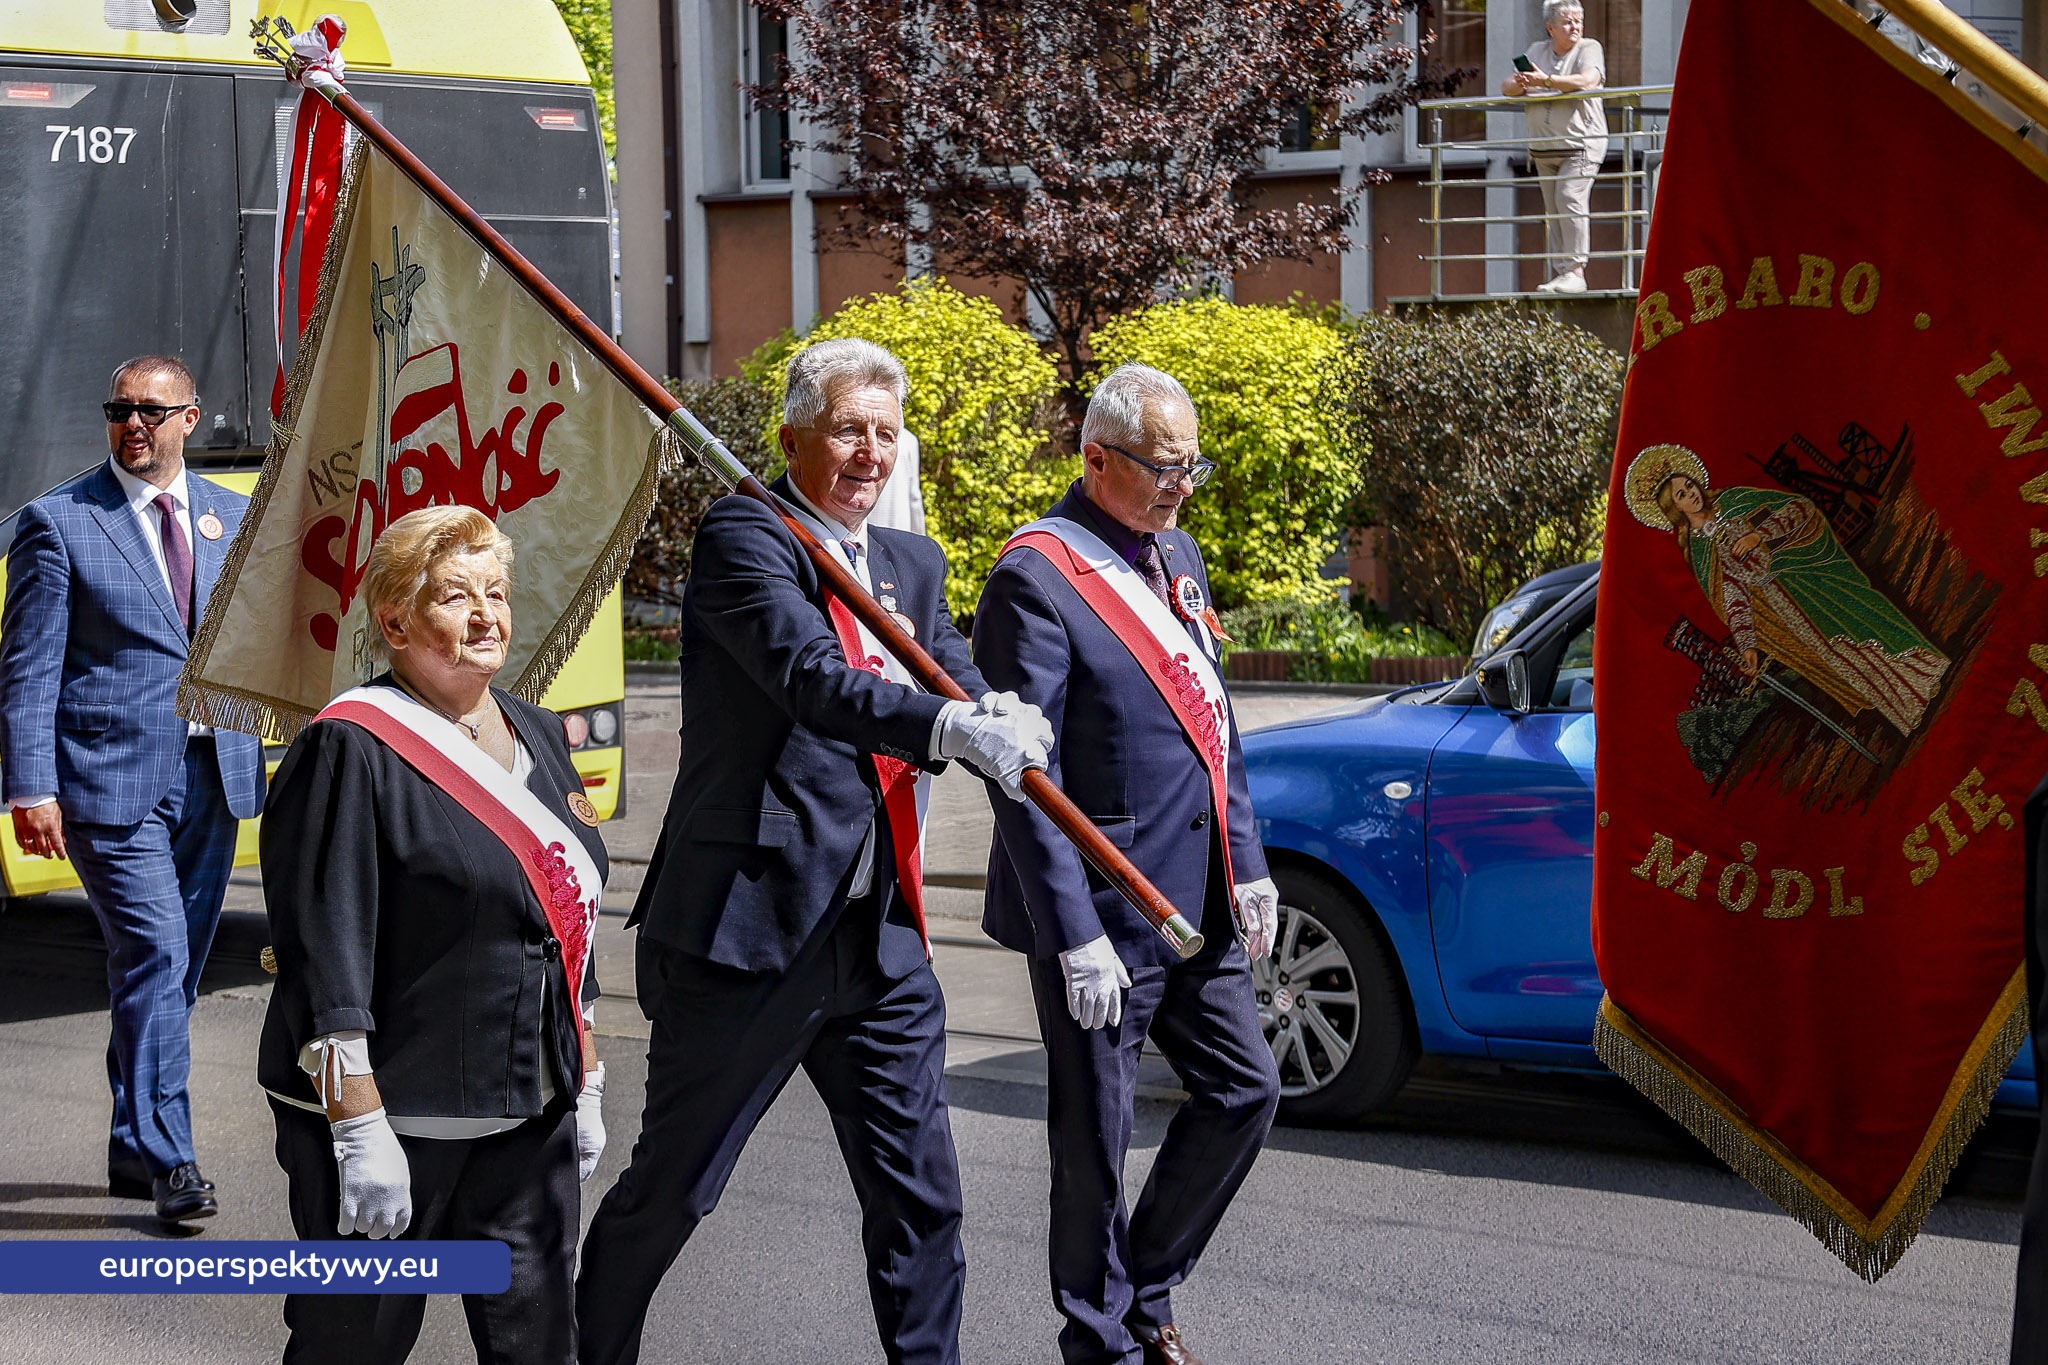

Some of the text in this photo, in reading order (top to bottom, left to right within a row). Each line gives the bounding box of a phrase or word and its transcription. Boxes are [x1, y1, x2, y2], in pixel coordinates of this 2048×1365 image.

[45, 125, 138, 164] 7187
[1628, 253, 1881, 372] RBARO
[1630, 831, 1865, 919] MÓDL
[1901, 766, 2015, 886] SIĘ
